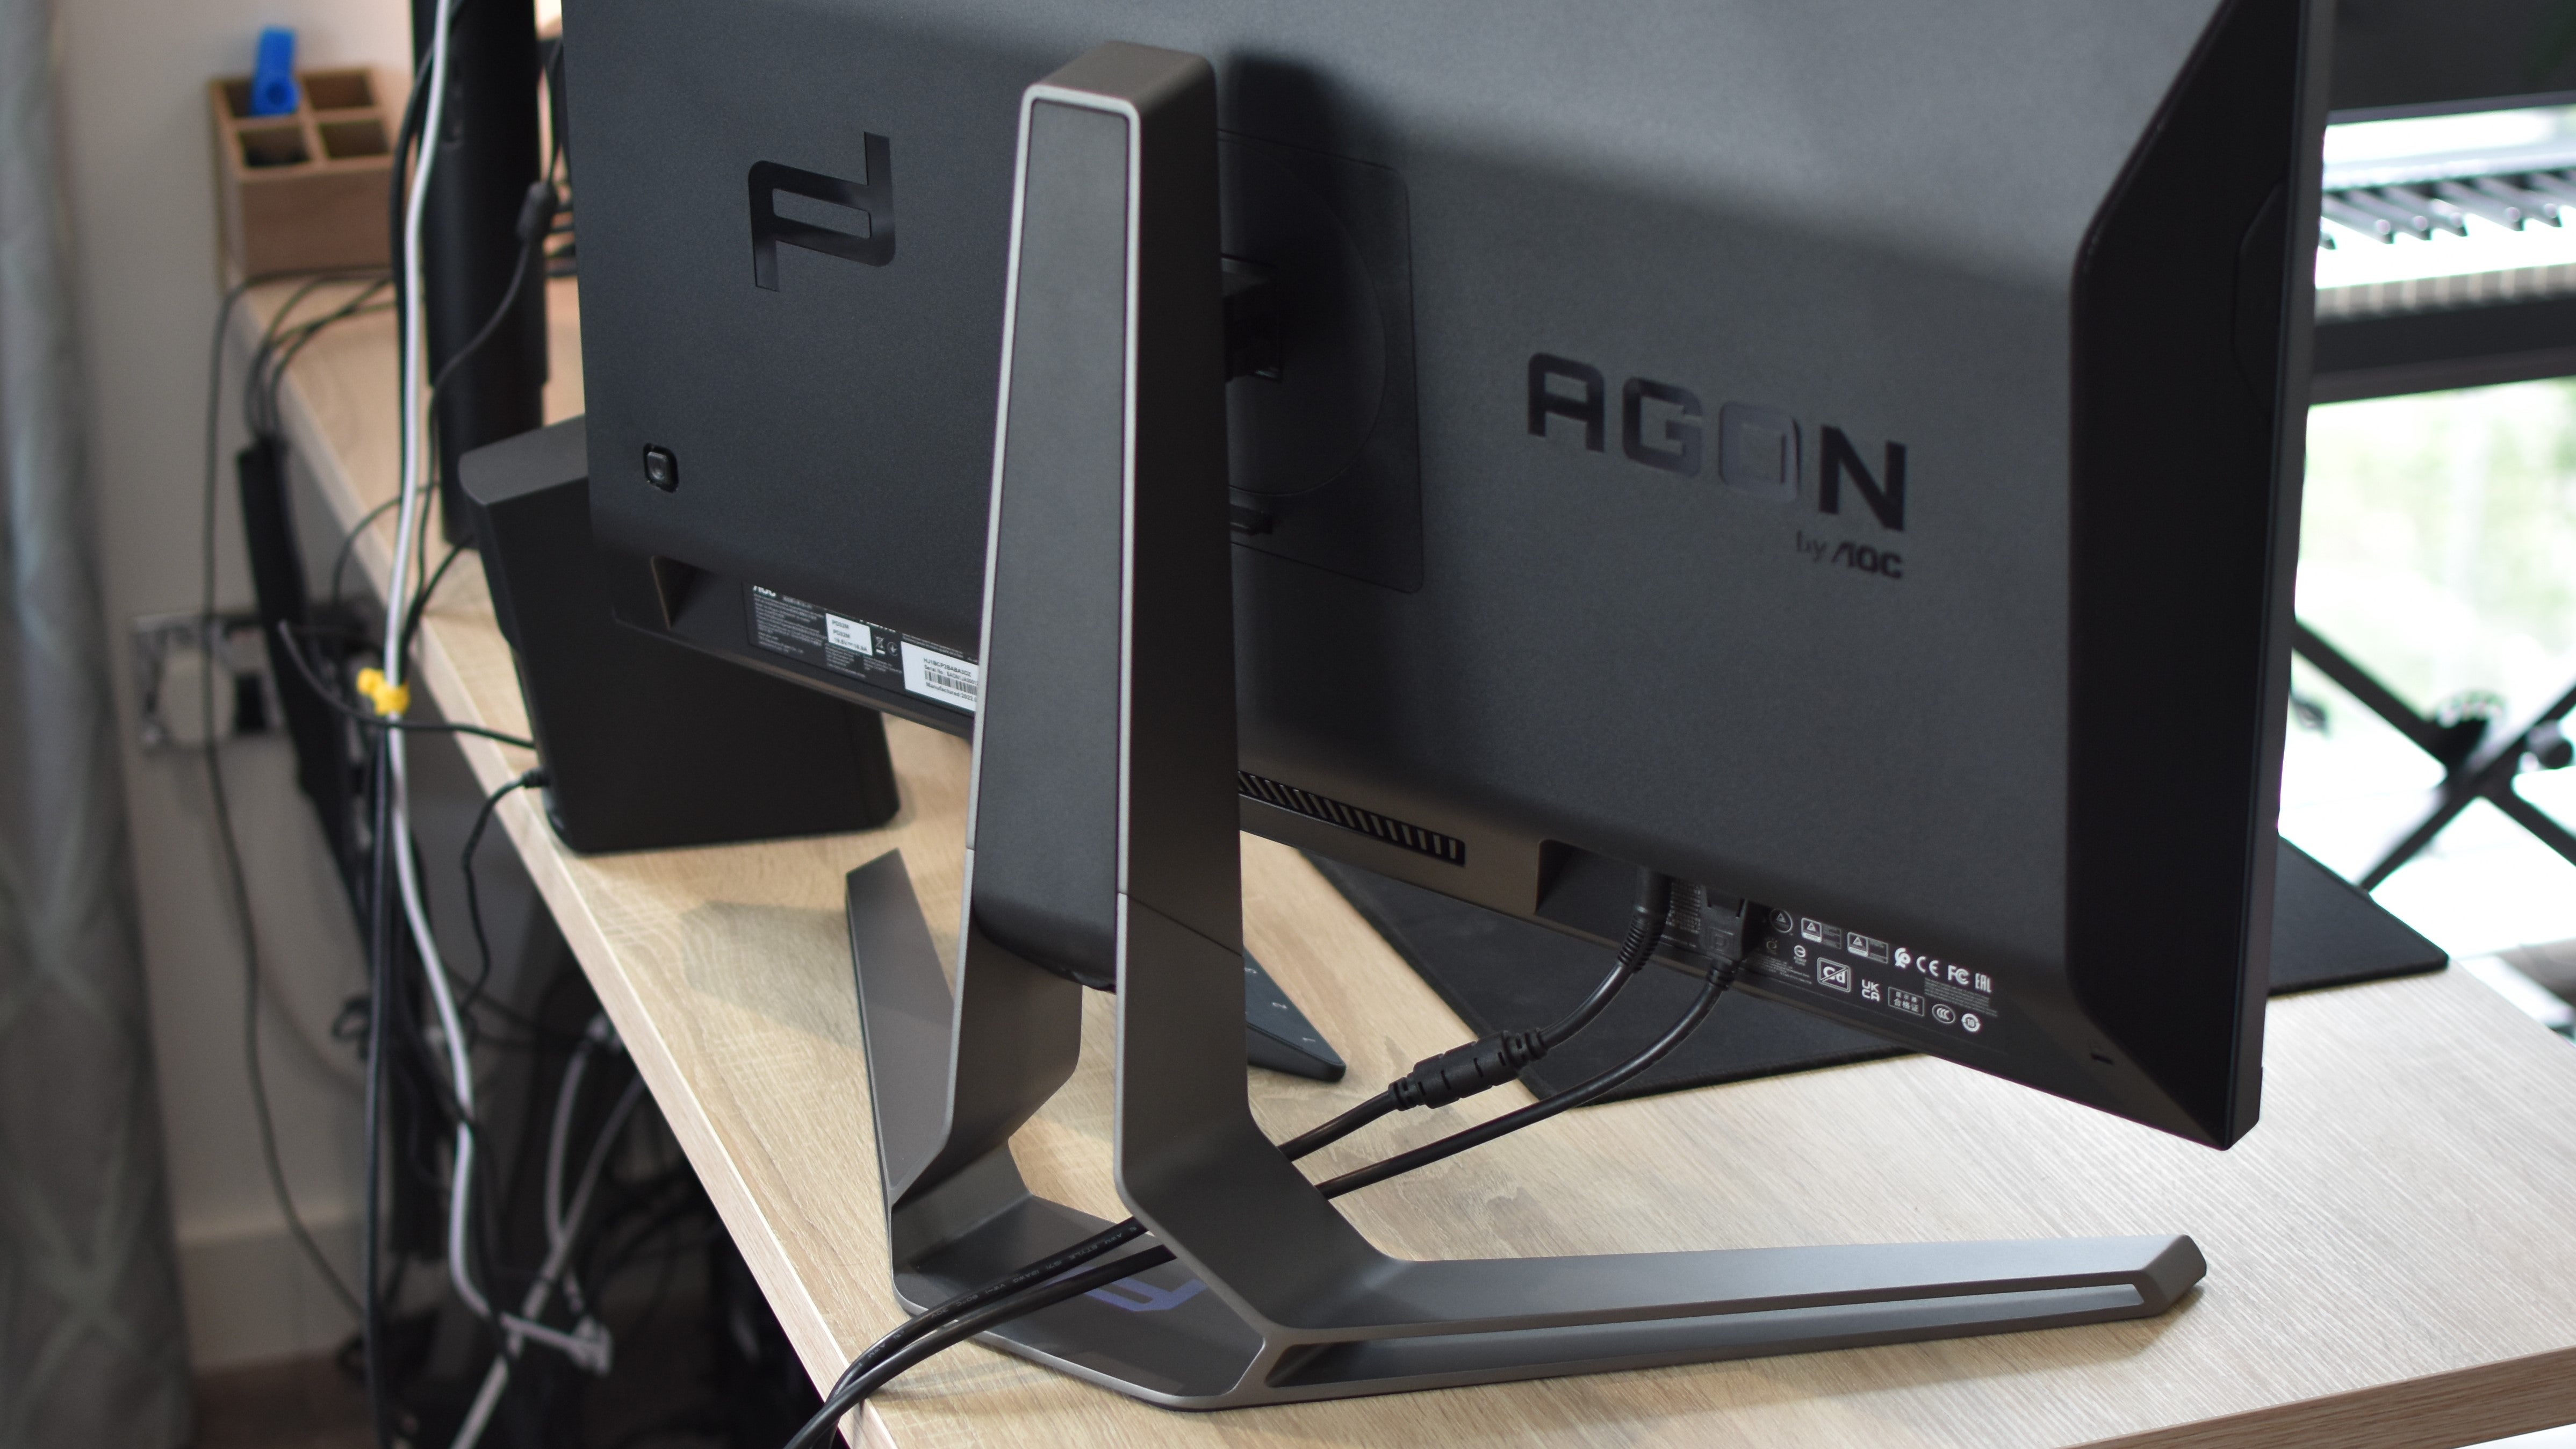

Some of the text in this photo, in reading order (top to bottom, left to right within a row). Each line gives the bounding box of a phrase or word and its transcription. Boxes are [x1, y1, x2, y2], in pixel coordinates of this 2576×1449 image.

[1528, 352, 1906, 532] AGON
[1796, 529, 1826, 563] by
[1916, 956, 1939, 977] CE
[1861, 979, 1879, 992] UK
[1861, 989, 1880, 1002] CA
[1105, 1232, 1122, 1244] AWM
[1069, 1244, 1098, 1259] STYLE
[868, 1343, 886, 1358] AWM
